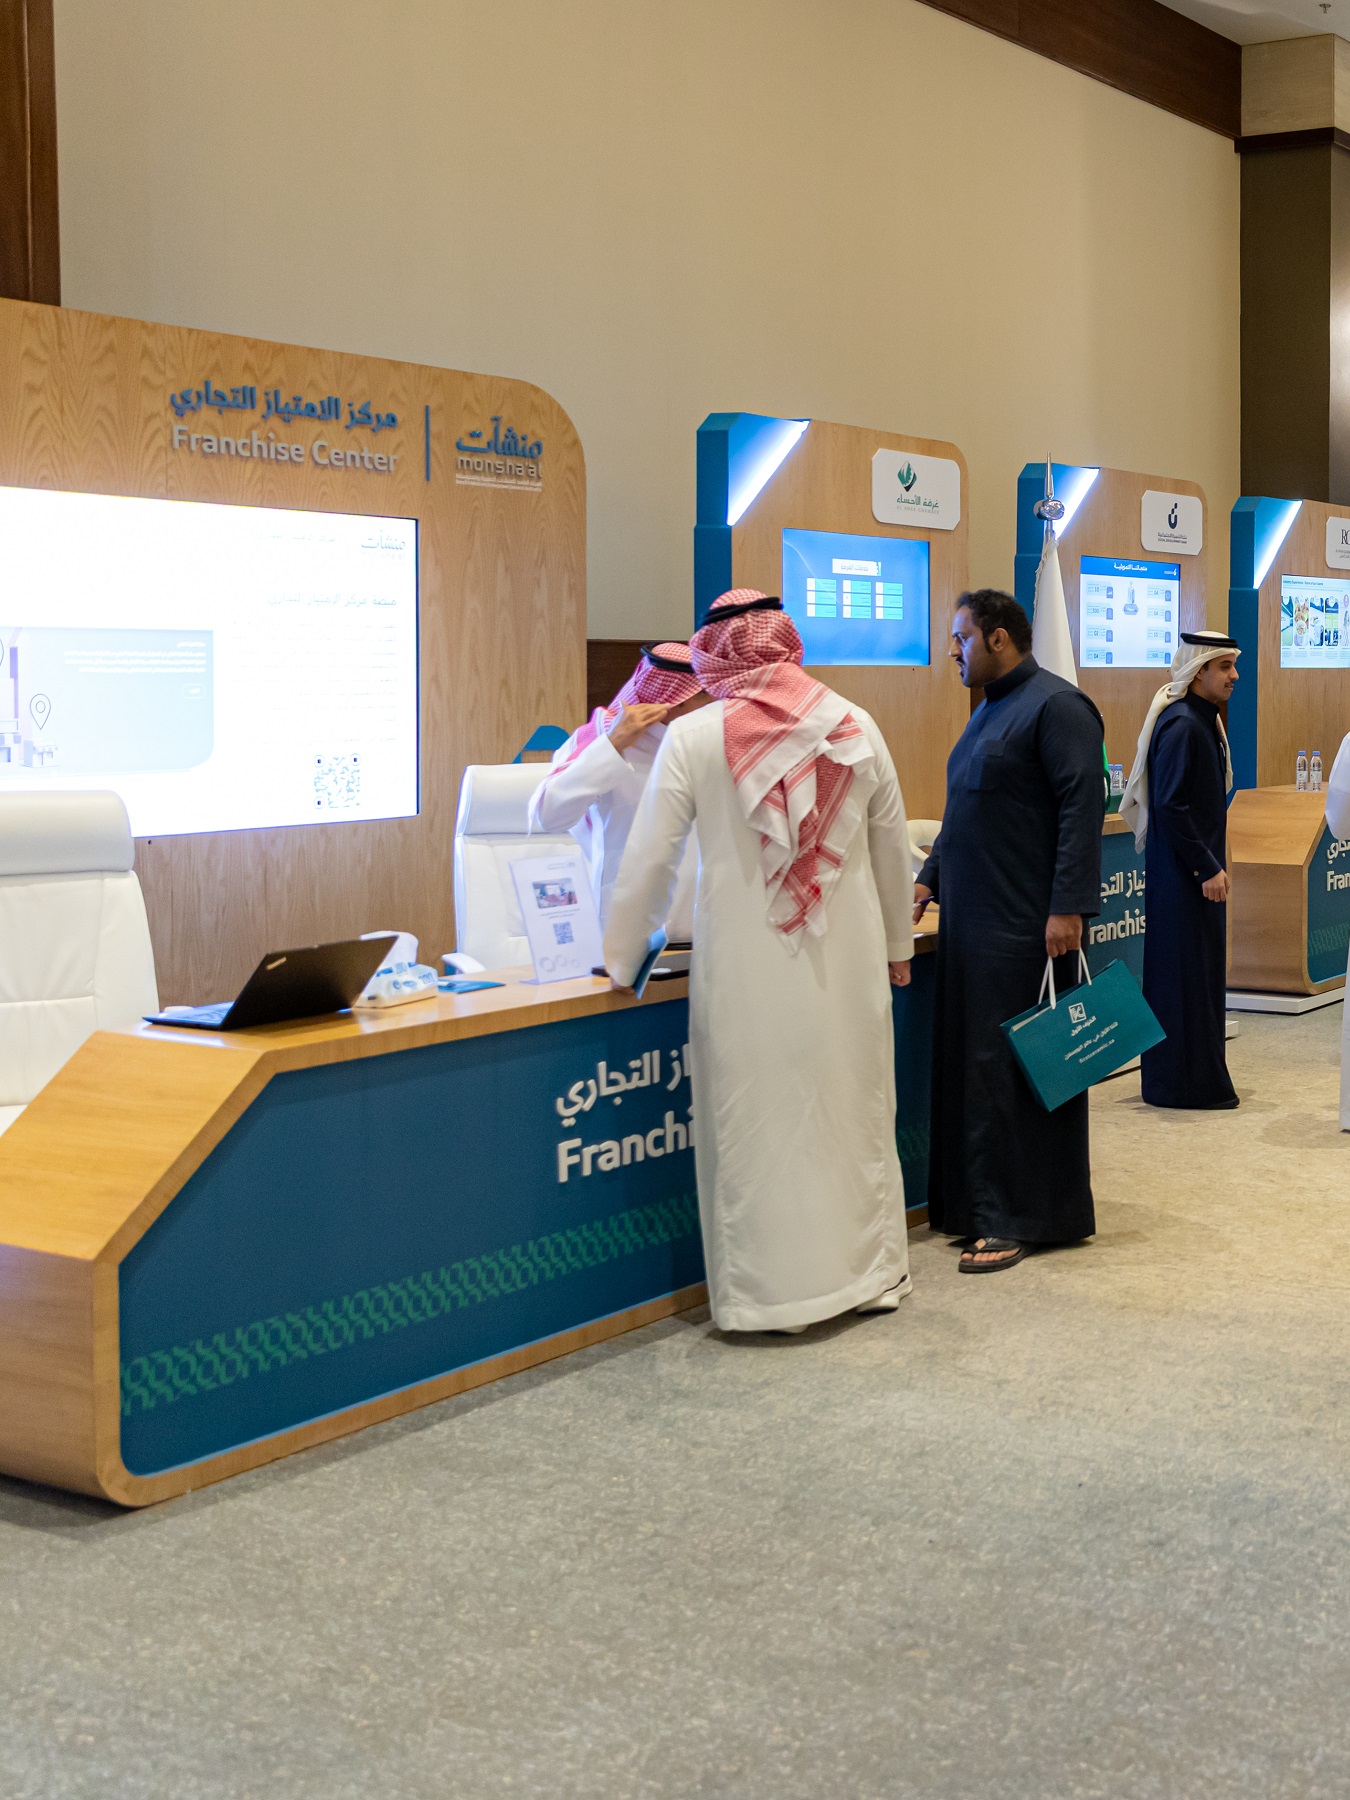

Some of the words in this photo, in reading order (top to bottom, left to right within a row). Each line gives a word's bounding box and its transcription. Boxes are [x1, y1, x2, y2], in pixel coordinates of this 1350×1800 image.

[170, 379, 256, 418] التجاري
[262, 388, 341, 422] الامتياز
[345, 400, 398, 433] مركز
[172, 424, 305, 463] Franchise
[312, 439, 399, 473] Center
[456, 415, 543, 458] منشآت
[897, 493, 921, 506] الأحساء
[923, 498, 939, 509] غرفة
[1089, 908, 1146, 945] ranchis
[556, 1049, 661, 1128] التجاري
[557, 1104, 696, 1183] Franchi
